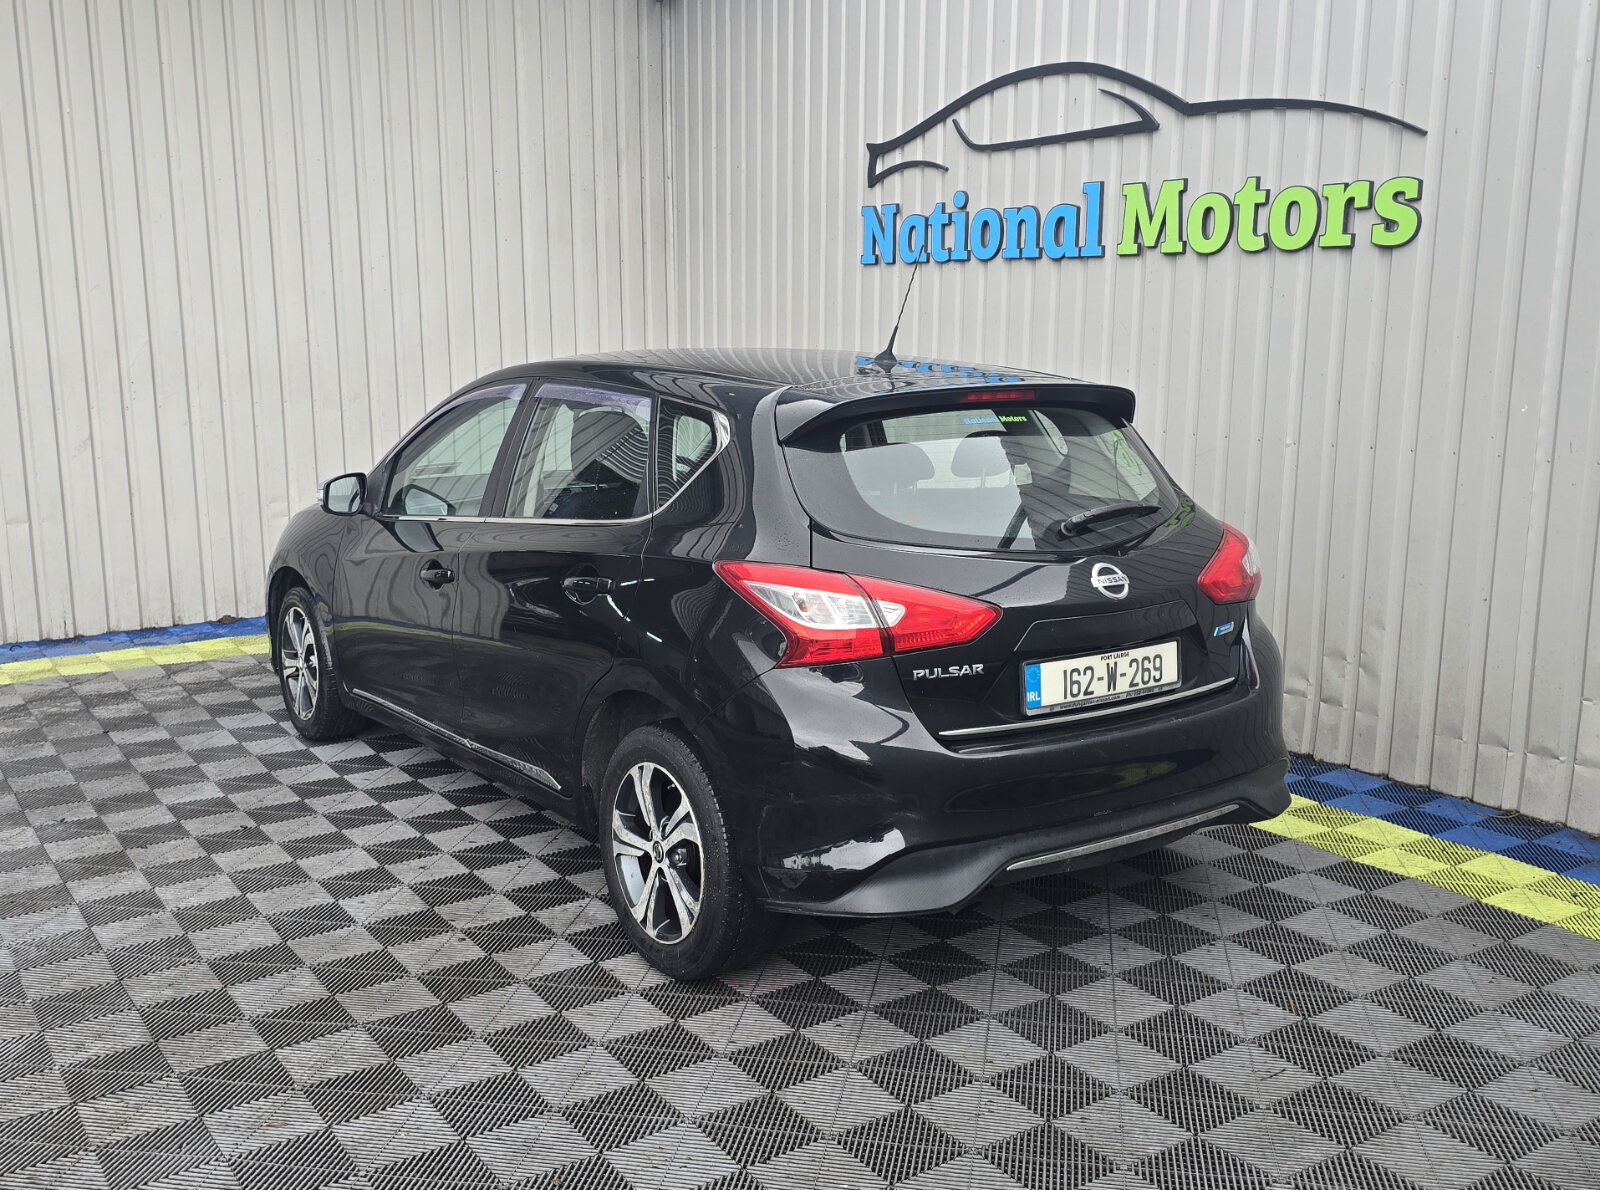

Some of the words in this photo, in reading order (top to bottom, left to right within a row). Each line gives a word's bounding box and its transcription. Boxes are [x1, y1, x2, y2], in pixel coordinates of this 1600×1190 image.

[861, 180, 1105, 265] National
[1117, 176, 1423, 256] Motors
[963, 416, 998, 424] National
[998, 415, 1027, 423] Motors
[1097, 575, 1128, 585] NISSAN
[913, 664, 984, 680] PULSAR
[1063, 654, 1163, 700] 162-W-269
[1026, 690, 1041, 702] IRL
